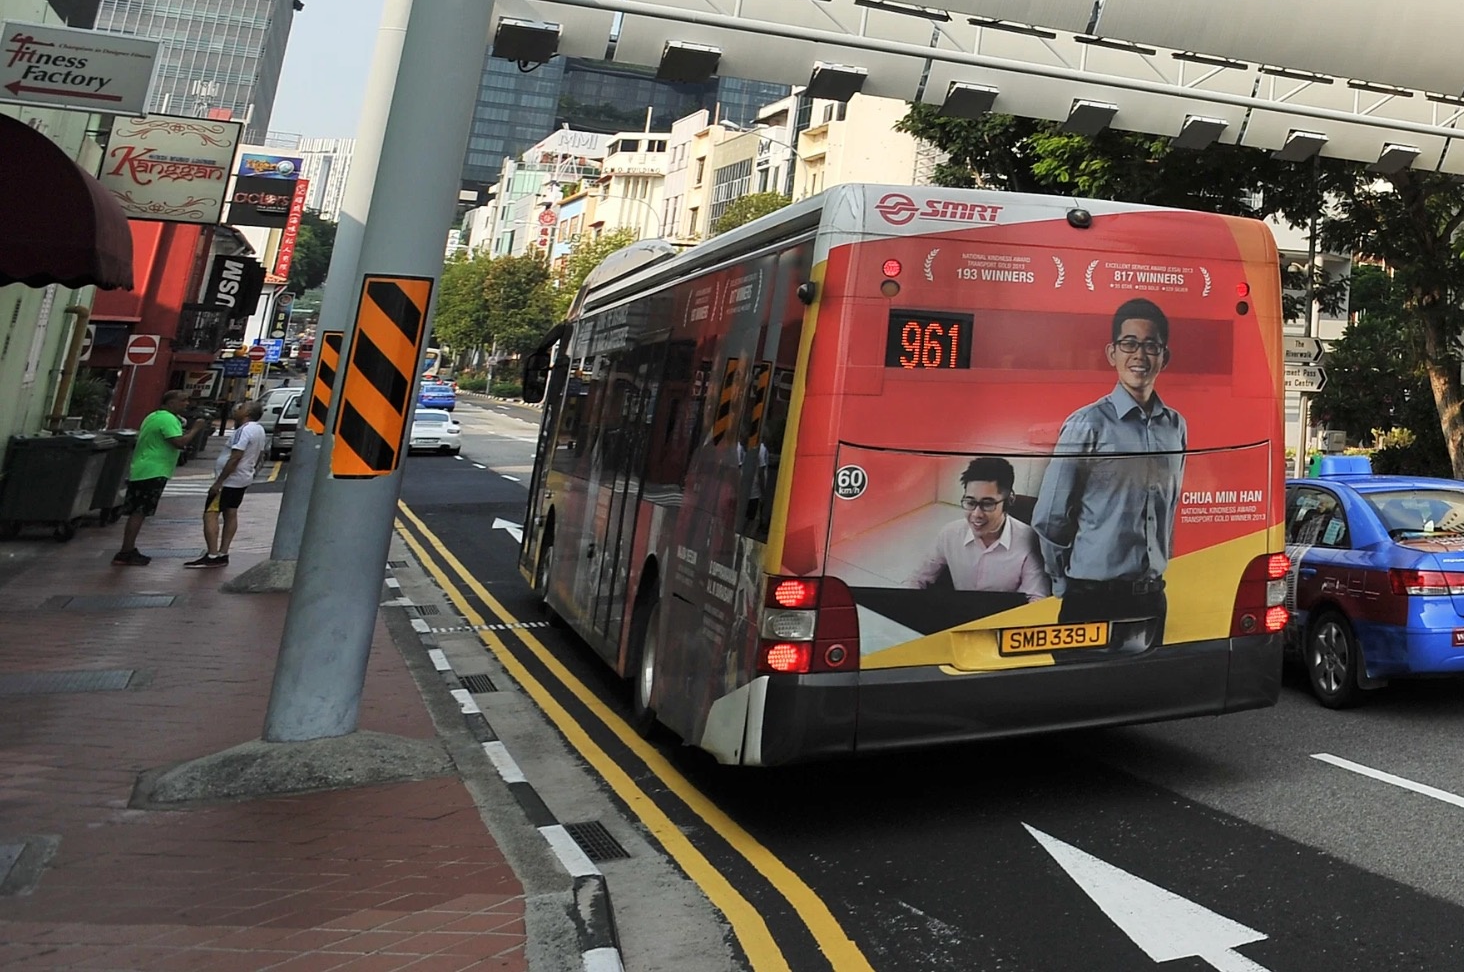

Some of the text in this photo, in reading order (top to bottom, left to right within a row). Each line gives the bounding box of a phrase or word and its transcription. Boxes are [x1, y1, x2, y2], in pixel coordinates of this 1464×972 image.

[22, 65, 112, 93] Factory
[106, 146, 226, 186] Kanggan
[919, 199, 1004, 223] SMRT
[968, 260, 997, 268] TRANSPORT
[956, 268, 1034, 283] 193 WINNERS
[1114, 270, 1184, 285] 817 WINNERS
[215, 259, 245, 308] USM
[899, 321, 959, 369] 961
[1295, 340, 1305, 348] The
[1303, 369, 1316, 377] Pass
[1294, 378, 1314, 387] Centre
[837, 470, 863, 487] 60
[1182, 490, 1263, 504] CHUA MIN HAN
[1181, 507, 1208, 515] NATIONAL
[1236, 505, 1257, 513] AWARD
[1181, 513, 1266, 523] TRANSPORT GOLD WINNER 2013
